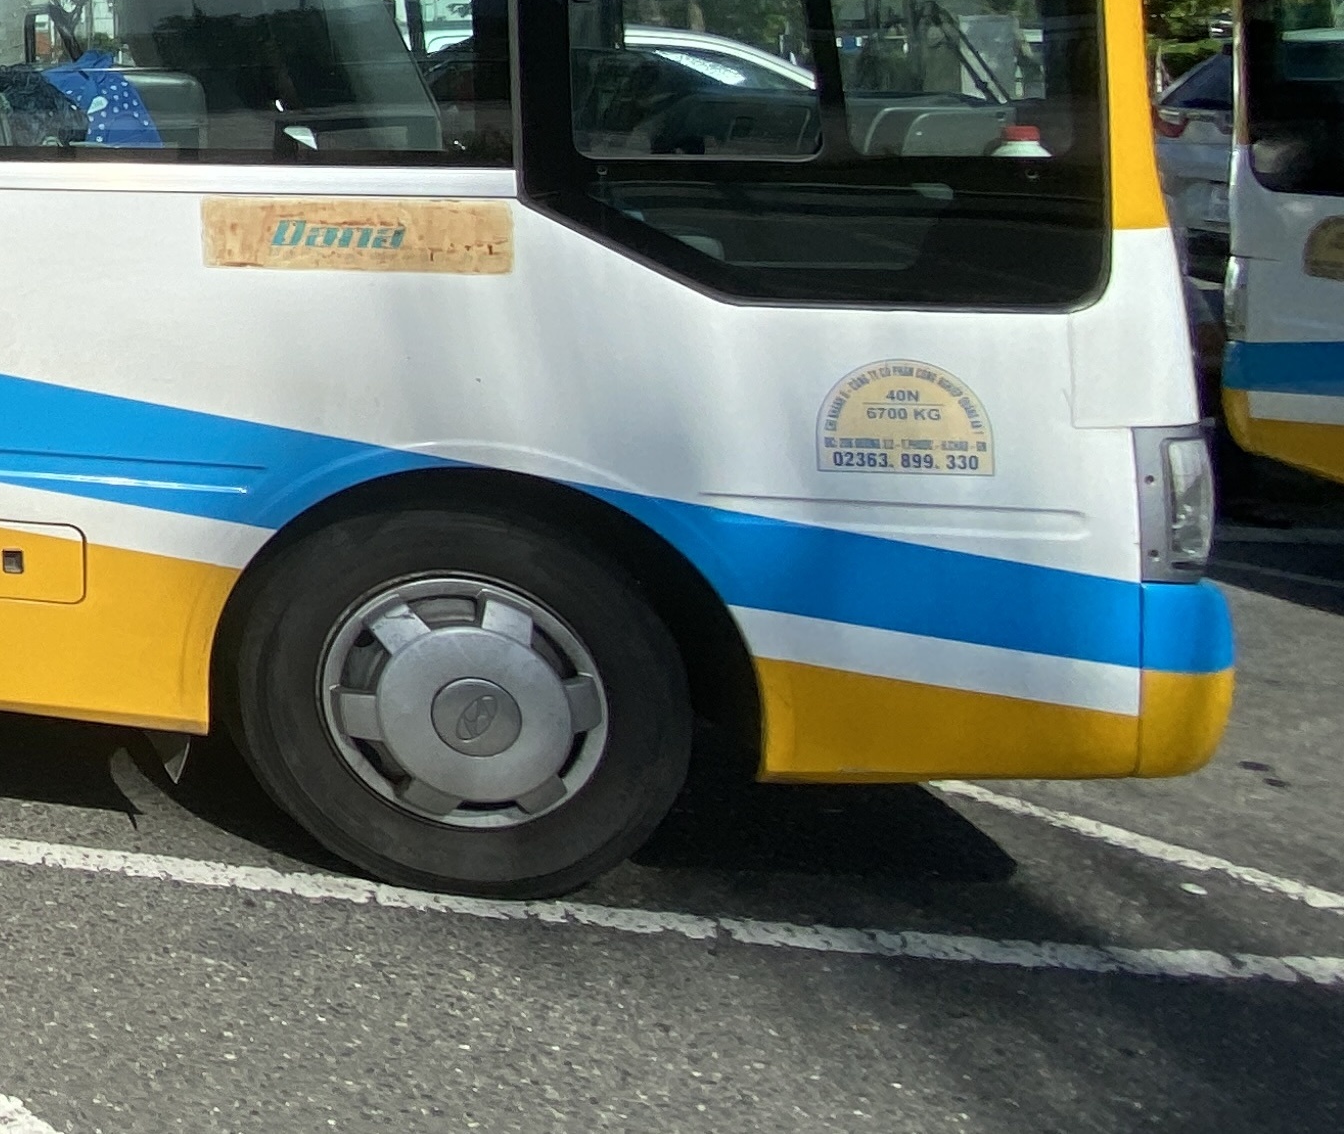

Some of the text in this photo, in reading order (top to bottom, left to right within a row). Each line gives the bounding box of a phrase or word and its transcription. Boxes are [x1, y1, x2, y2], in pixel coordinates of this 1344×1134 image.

[885, 389, 920, 403] 40N
[866, 407, 941, 421] 6700 KG
[945, 454, 980, 471] 330
